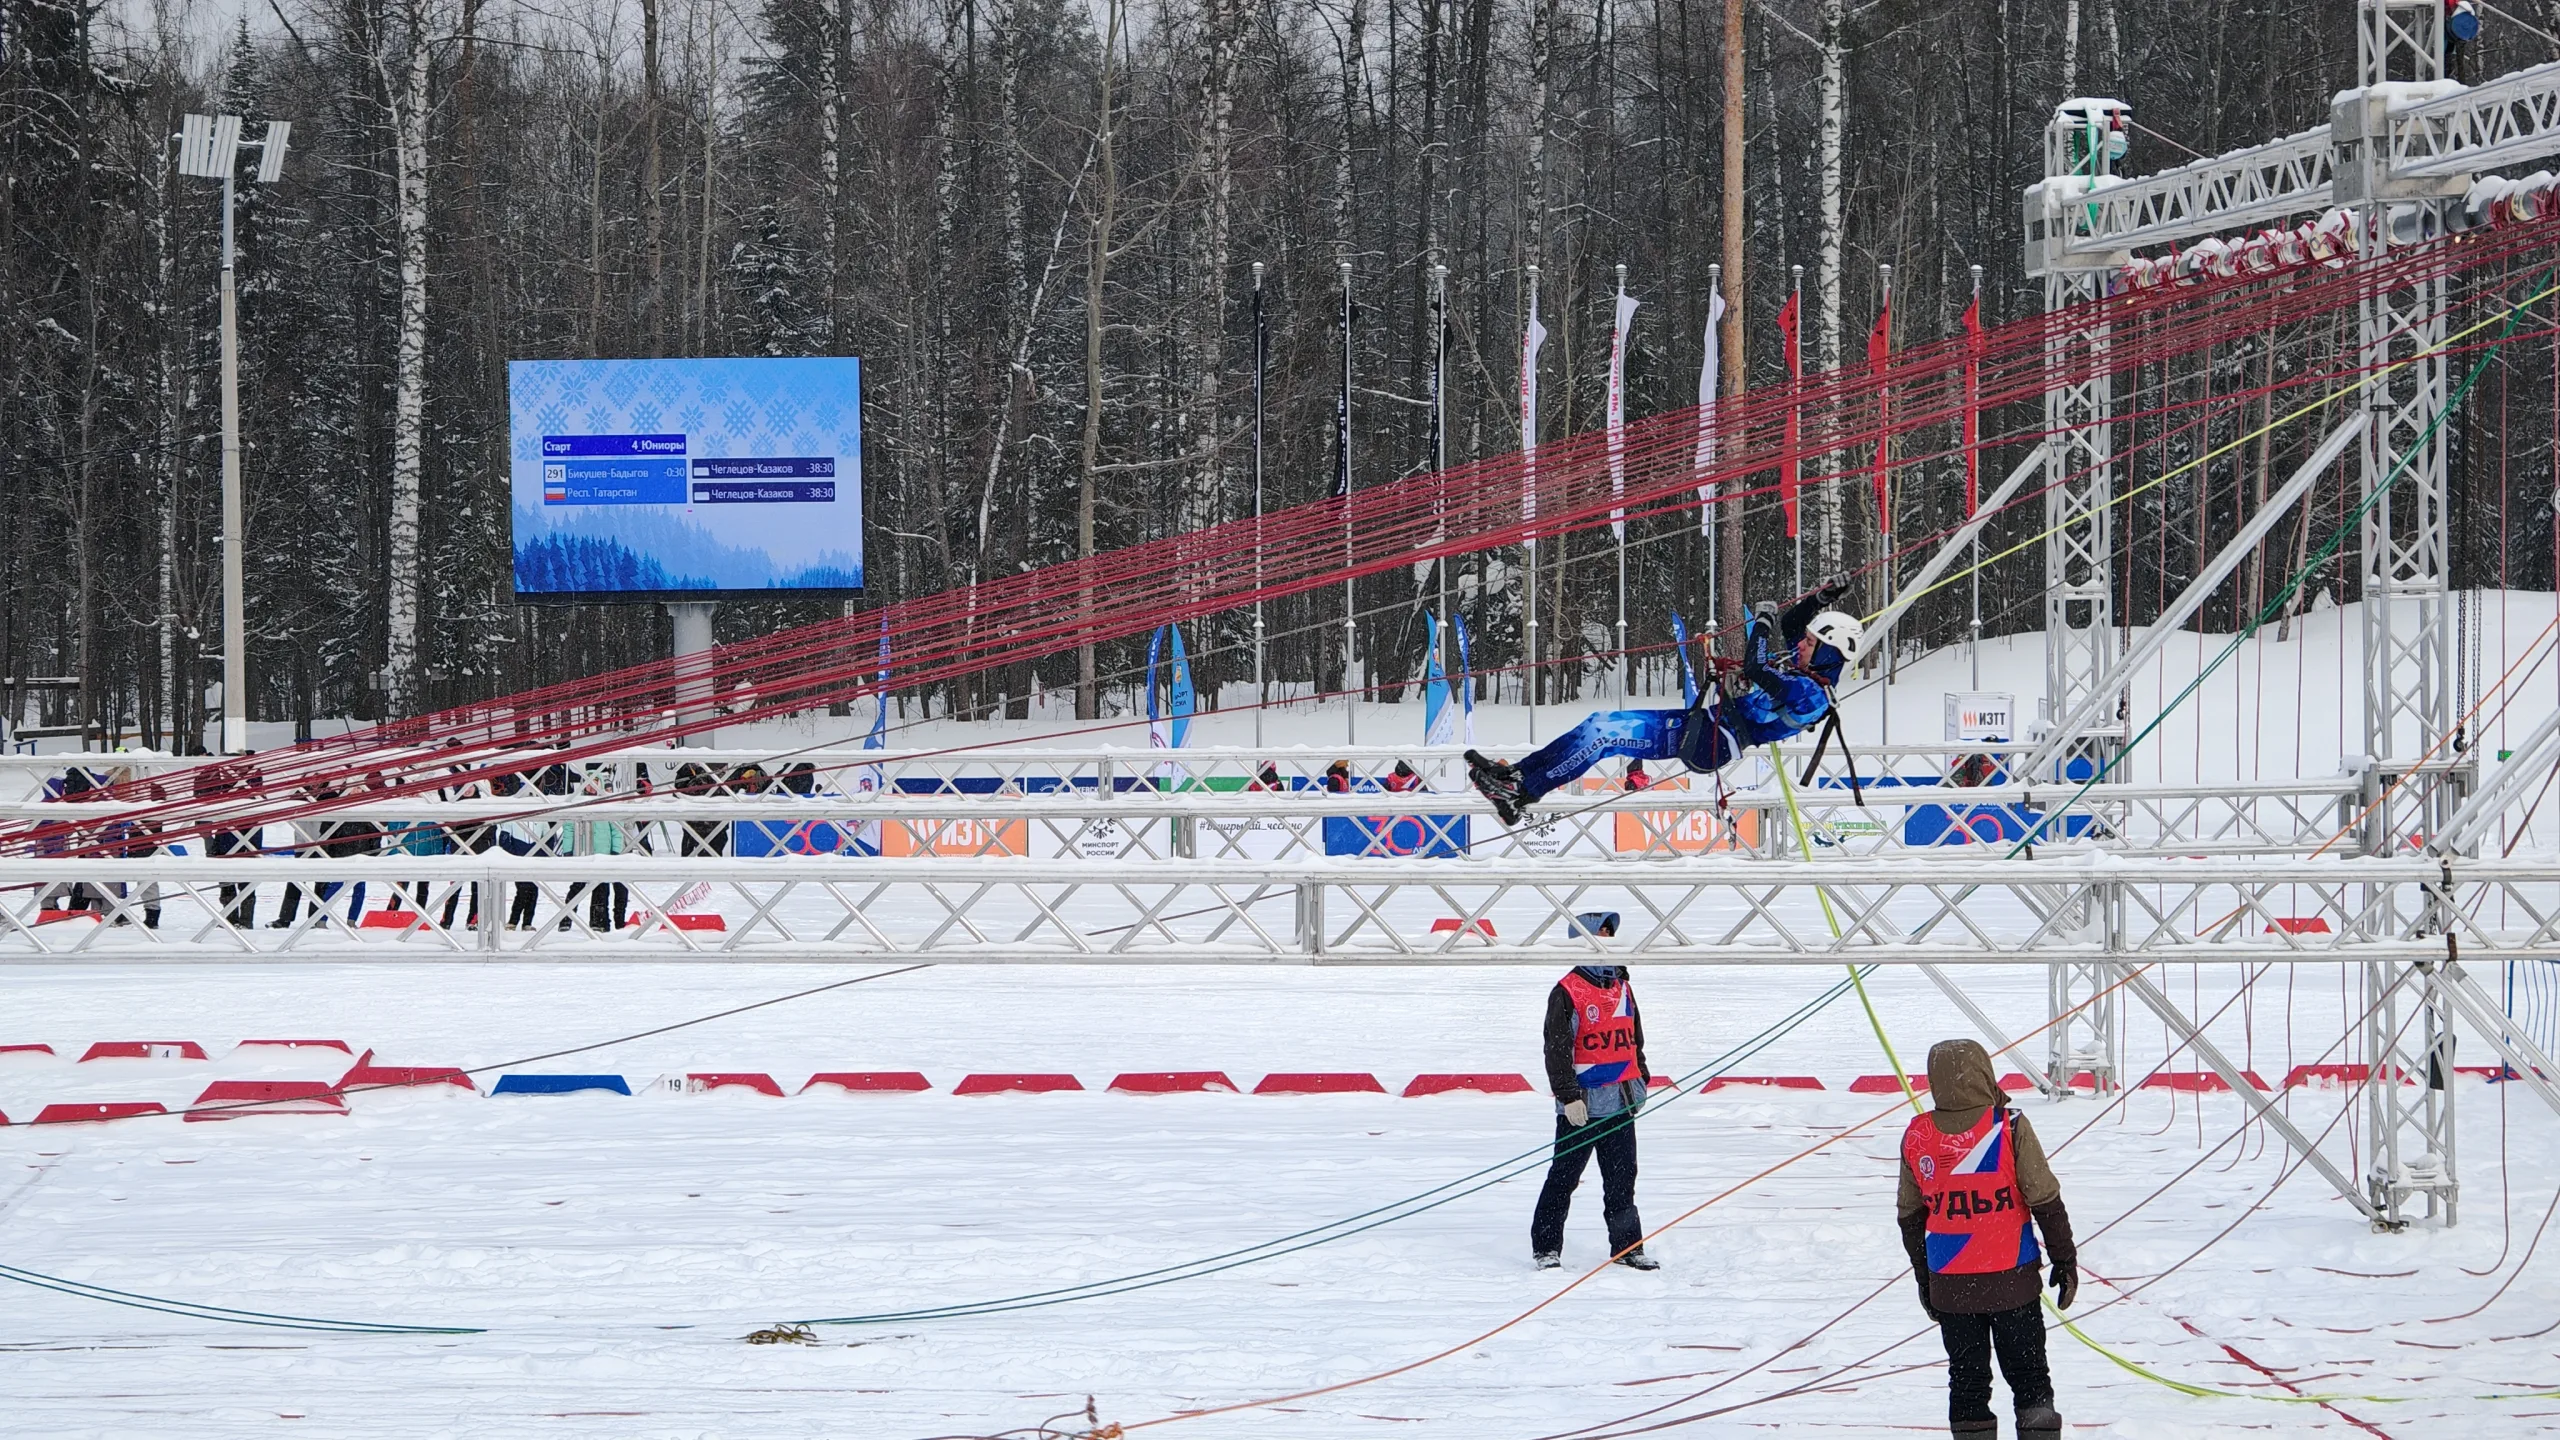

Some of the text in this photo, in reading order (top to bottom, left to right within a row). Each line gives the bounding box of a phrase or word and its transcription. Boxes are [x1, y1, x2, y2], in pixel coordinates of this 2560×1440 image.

[544, 440, 685, 453] Старт 4_Юниоры
[547, 467, 685, 478] 291 Бикушев-Бадыгов -0:30
[711, 463, 833, 474] Чеглецов-Казаков -38:30
[567, 487, 637, 499] Респ. Татарстан
[711, 488, 833, 499] Чеглецов-Казаков -38:30
[1676, 810, 1731, 841] ИЗТ
[668, 1079, 681, 1092] 19
